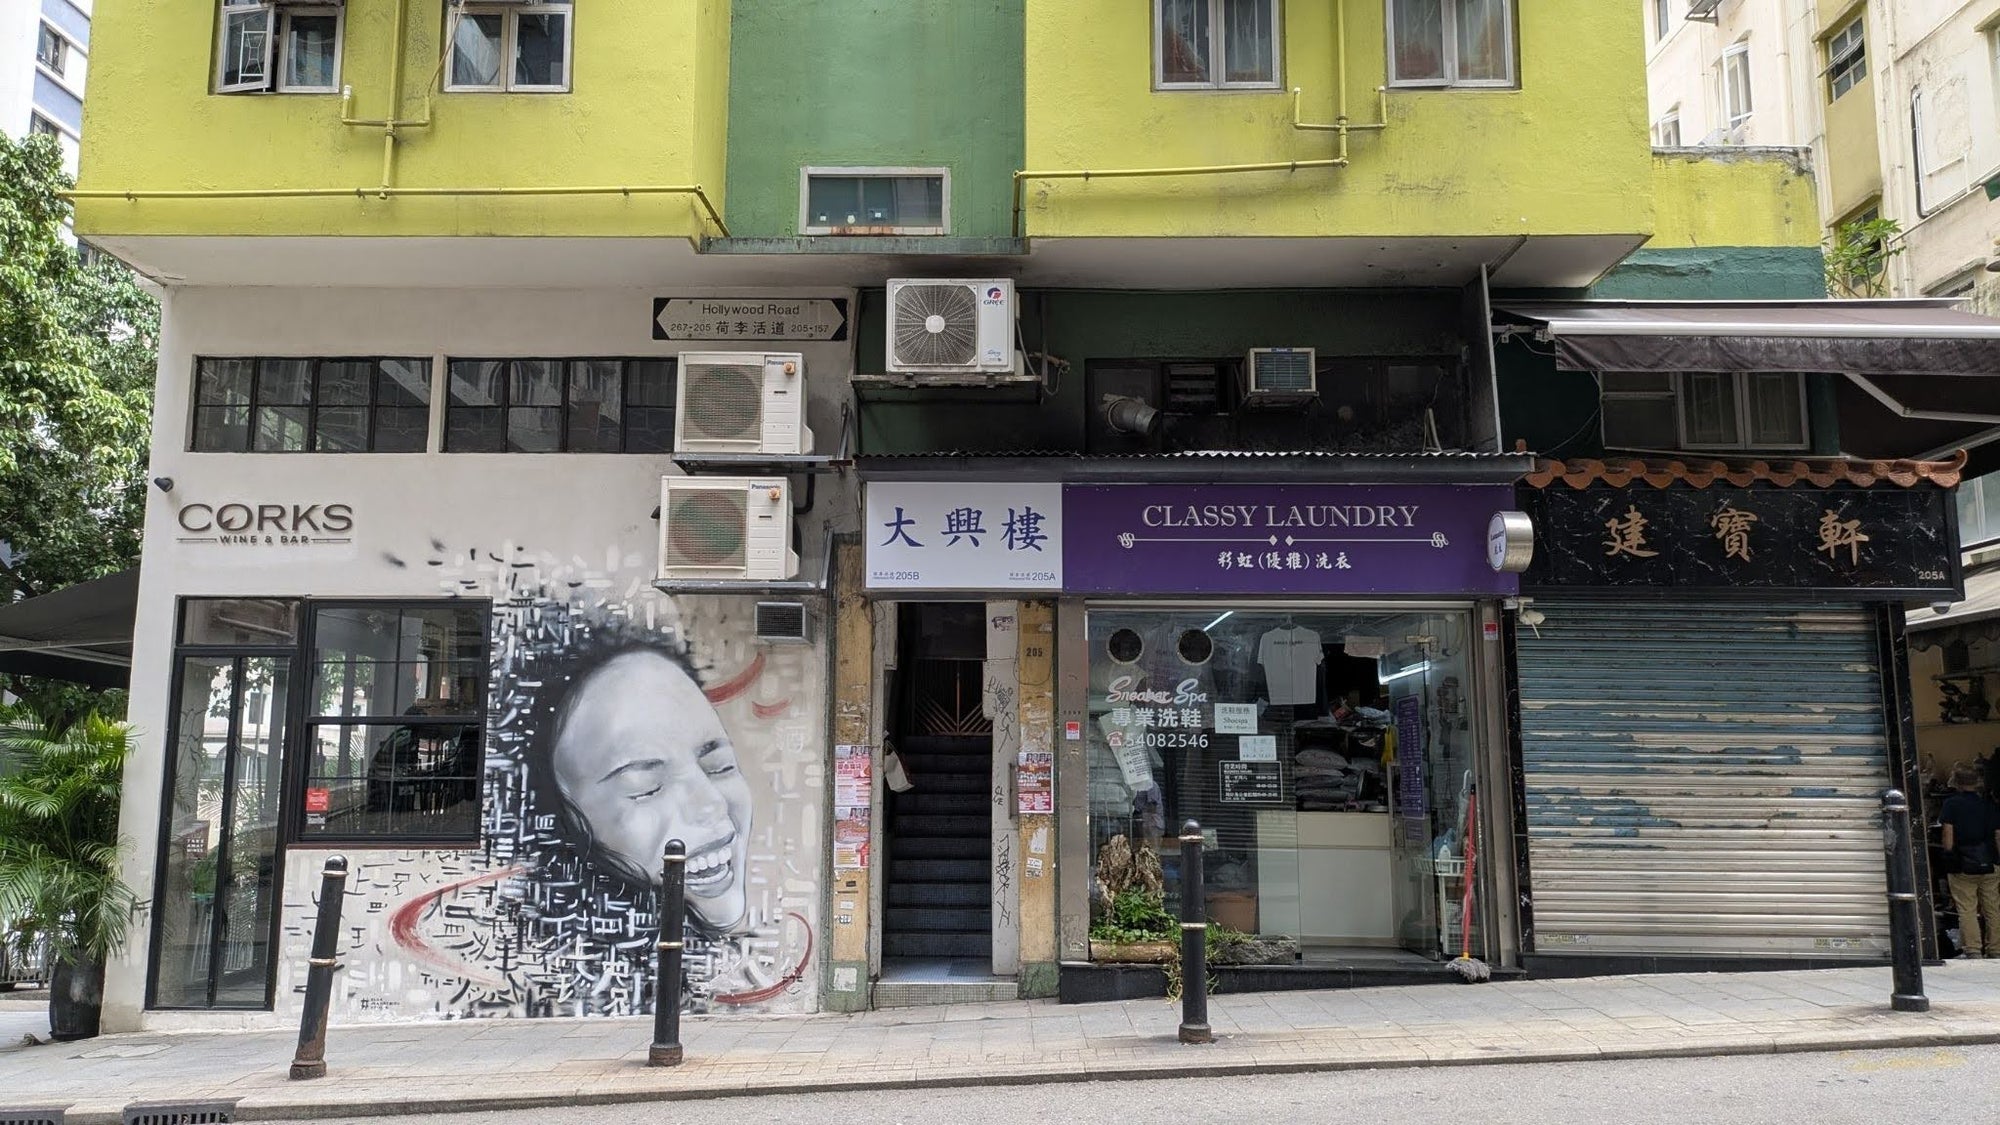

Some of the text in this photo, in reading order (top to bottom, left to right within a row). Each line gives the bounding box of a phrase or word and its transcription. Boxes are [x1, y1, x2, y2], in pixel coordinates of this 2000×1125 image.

[702, 303, 800, 316] Hollywood Road
[716, 321, 785, 336] 荷李活道
[178, 503, 353, 532] CORKS
[1142, 505, 1419, 527] CLASSY LAUNDRY
[881, 506, 1048, 552] 大興樓
[1602, 505, 1870, 566] 建寶軒
[220, 535, 309, 544] WINE & BAR
[1217, 551, 1352, 570] 彩虹(優雅)洗衣
[895, 571, 920, 580] 205B
[1031, 572, 1056, 581] 205A
[1918, 570, 1945, 580] 205A
[1026, 647, 1043, 657] 205
[1105, 676, 1209, 706] Sneaker Spa
[1111, 707, 1202, 728] 專業洗鞋
[1125, 732, 1209, 748] 54082546
